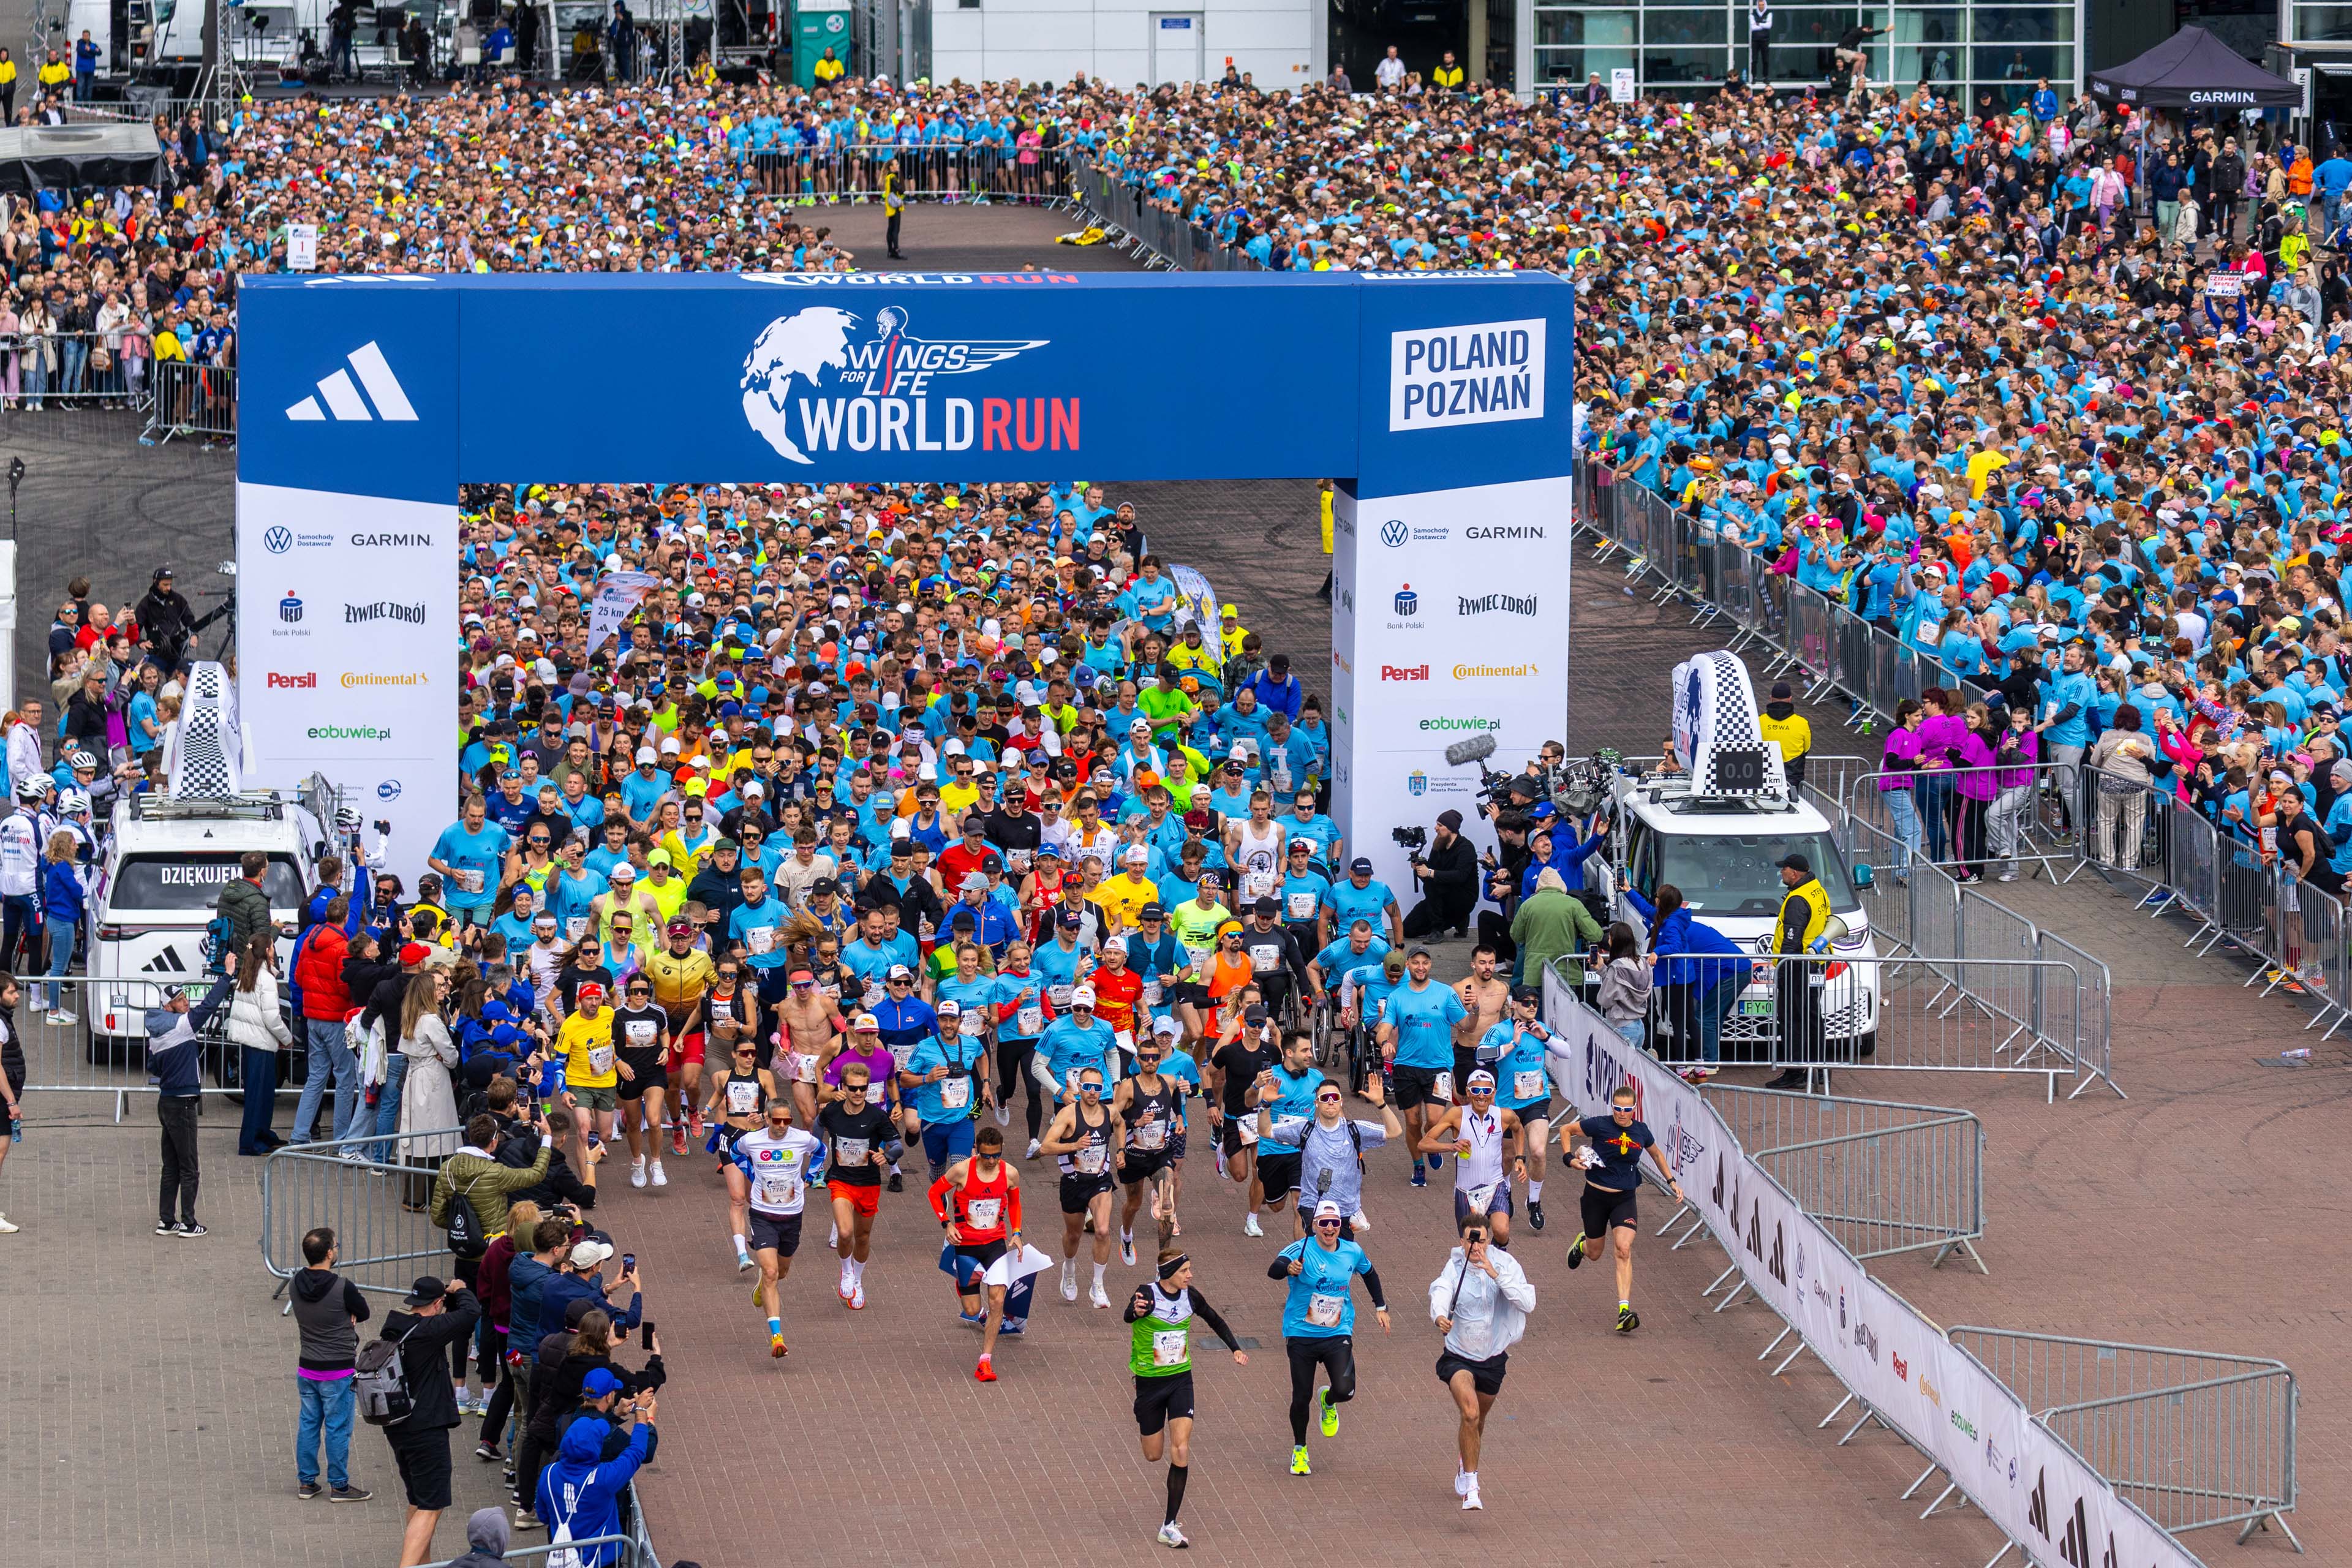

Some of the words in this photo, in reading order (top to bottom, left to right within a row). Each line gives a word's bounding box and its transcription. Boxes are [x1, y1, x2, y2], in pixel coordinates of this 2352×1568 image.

[980, 274, 1080, 284] RUN
[1405, 330, 1529, 375] POLAND
[840, 371, 864, 383] FOR
[862, 371, 934, 396] LIFE
[1404, 364, 1531, 420] POZNAŃ
[799, 398, 974, 451] WORLD
[982, 398, 1080, 451] RUN
[1413, 527, 1450, 535] Samochody
[344, 601, 387, 624] ŻYWIEC
[388, 600, 426, 625] ZDRÓJ
[598, 606, 609, 616] 25
[611, 606, 625, 618] km
[1458, 594, 1499, 616] ŻYWIEC
[1501, 593, 1537, 617] ZDRÓJ
[292, 628, 311, 637] Polski
[268, 672, 317, 688] Persil
[340, 672, 417, 688] Continental
[1381, 665, 1430, 681] Persil
[1452, 663, 1527, 680] Continental
[307, 724, 391, 741] eobuwie.pl
[1419, 715, 1501, 732] eobuwie.pl
[1724, 763, 1754, 779] 0.0
[161, 867, 244, 887] DZIĘKUJEM
[29, 892, 42, 912] POL
[963, 1019, 979, 1028] 18132
[1594, 1042, 1624, 1107] WORLD
[1814, 1279, 1831, 1309] GARMIN
[1893, 1351, 1907, 1382] Persil
[1951, 1409, 1978, 1444] eobuwie.pl
